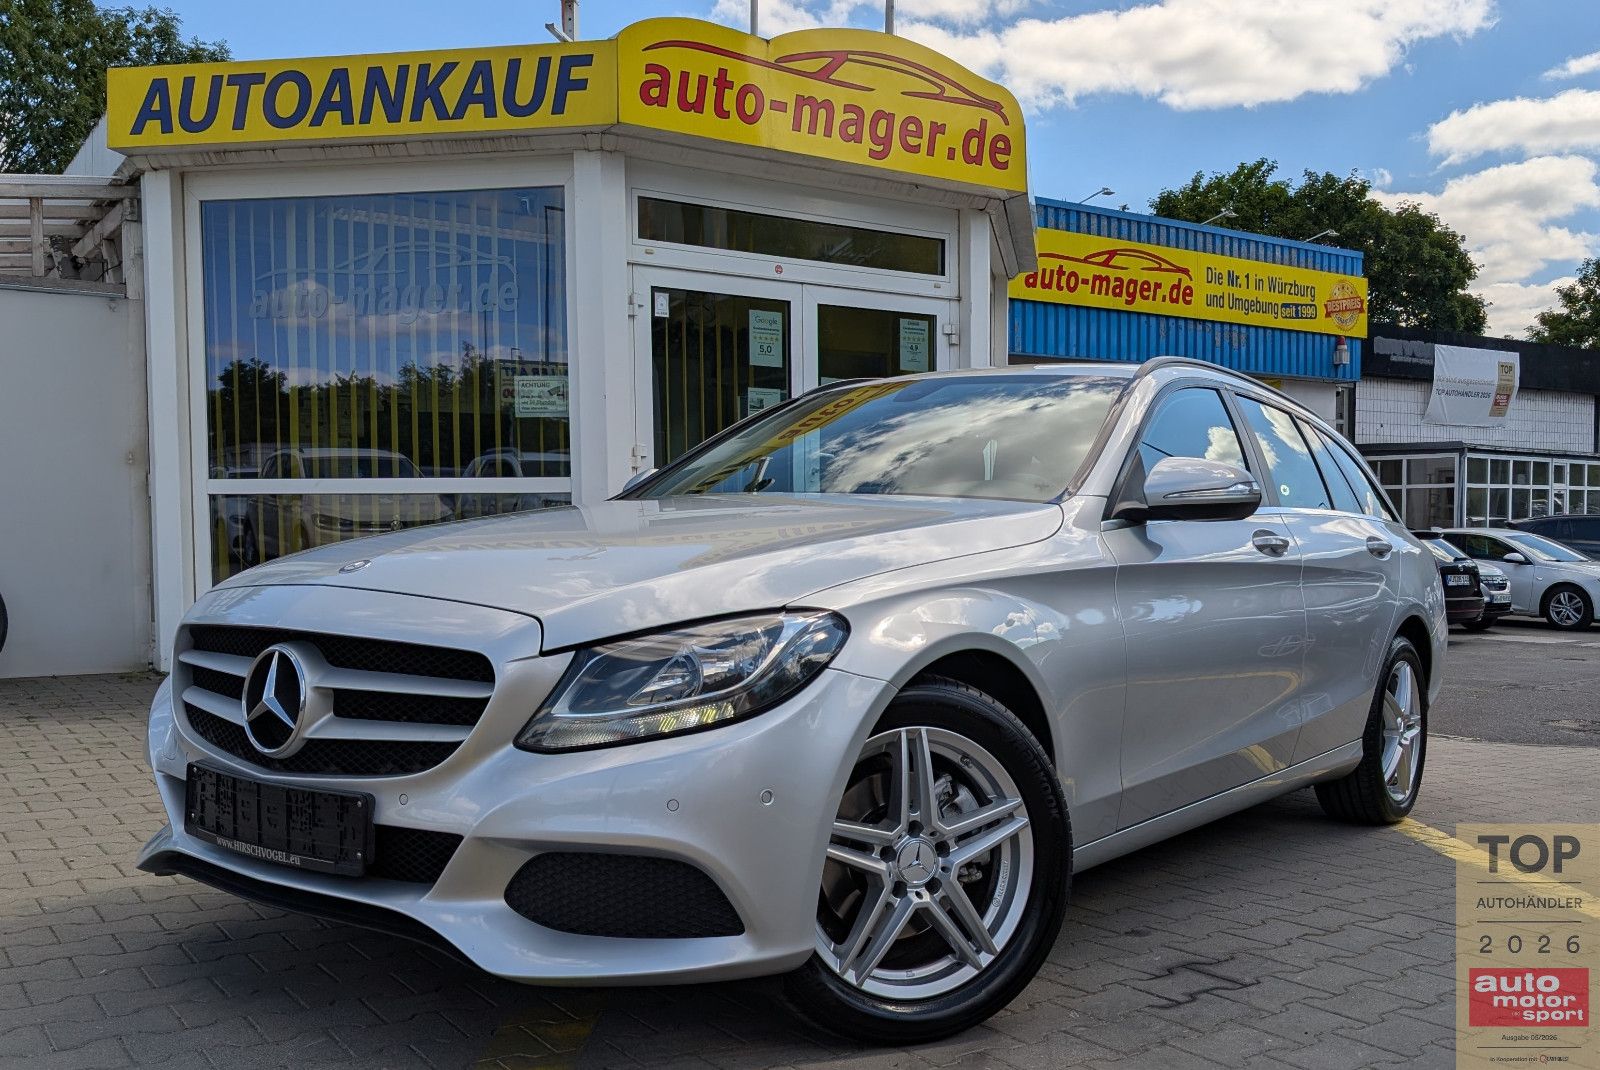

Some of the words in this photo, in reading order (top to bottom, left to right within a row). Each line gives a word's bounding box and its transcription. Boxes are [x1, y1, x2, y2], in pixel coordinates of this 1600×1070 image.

[129, 53, 594, 136] AUTOANKAUF
[639, 62, 1012, 170] auto-mager.de
[253, 271, 519, 327] auto-mager.de
[1024, 264, 1194, 306] auto-mager.de
[1206, 266, 1223, 285] Die
[1228, 270, 1242, 289] Nr.
[1244, 273, 1250, 290] 1
[1255, 274, 1264, 292] in
[1268, 275, 1316, 303] Würzburg
[754, 315, 778, 326] Google
[1206, 292, 1224, 309] und
[1228, 292, 1279, 320] Umgebung
[1281, 305, 1296, 318] seit
[1298, 305, 1317, 318] 1999
[1327, 298, 1361, 313] BESTPREIS
[759, 344, 772, 356] 5,0
[1500, 364, 1513, 375] TOP
[216, 836, 300, 866] www.HIRSCHVOGEL.eu
